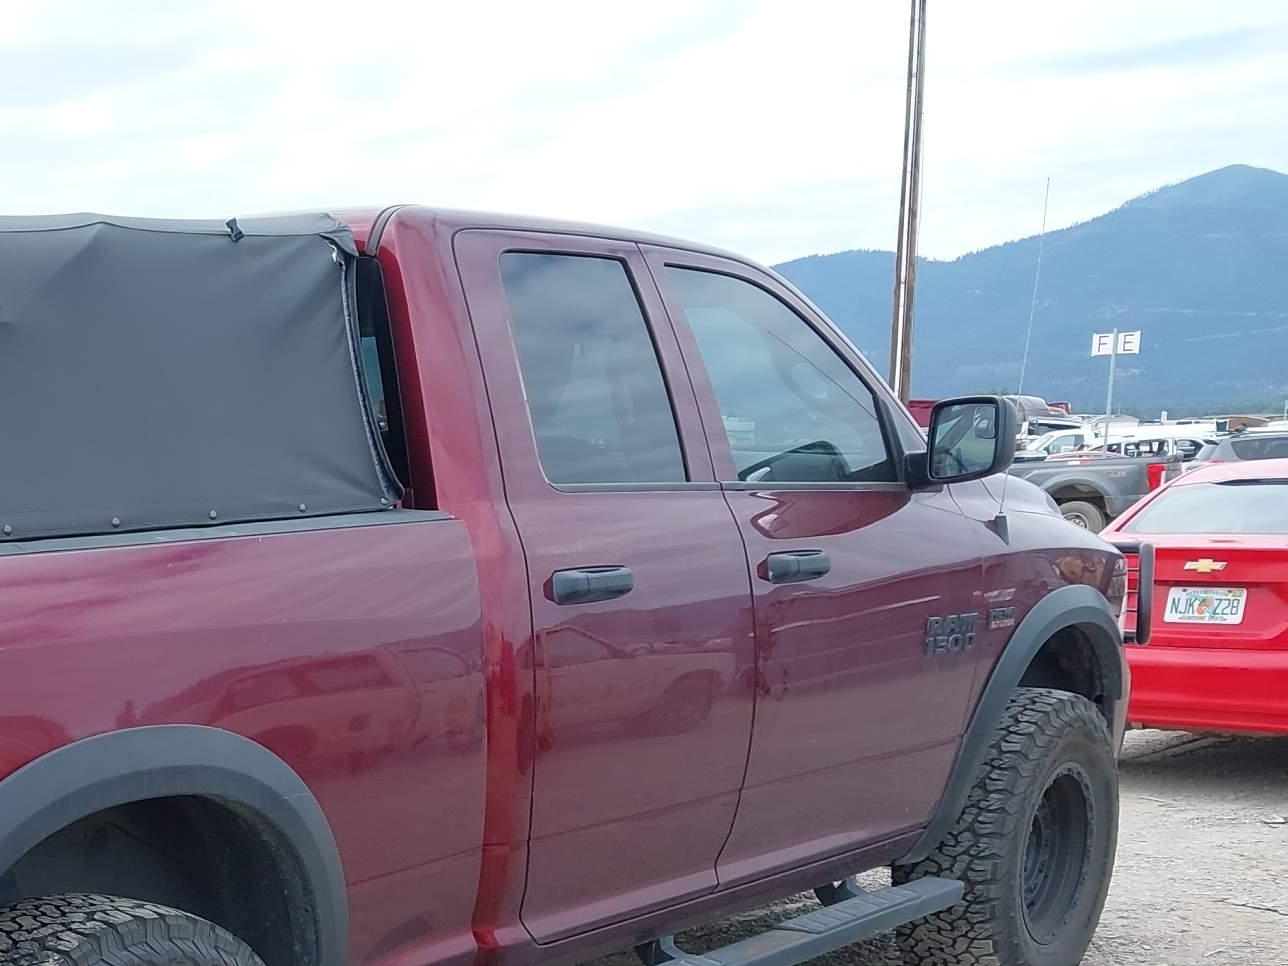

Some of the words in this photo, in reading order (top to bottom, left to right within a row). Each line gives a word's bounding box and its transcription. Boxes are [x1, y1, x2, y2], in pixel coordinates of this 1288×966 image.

[1097, 335, 1110, 353] F
[1122, 333, 1136, 352] E
[1170, 597, 1196, 615] NJK
[926, 612, 979, 634] RAM
[925, 633, 976, 656] 1500
